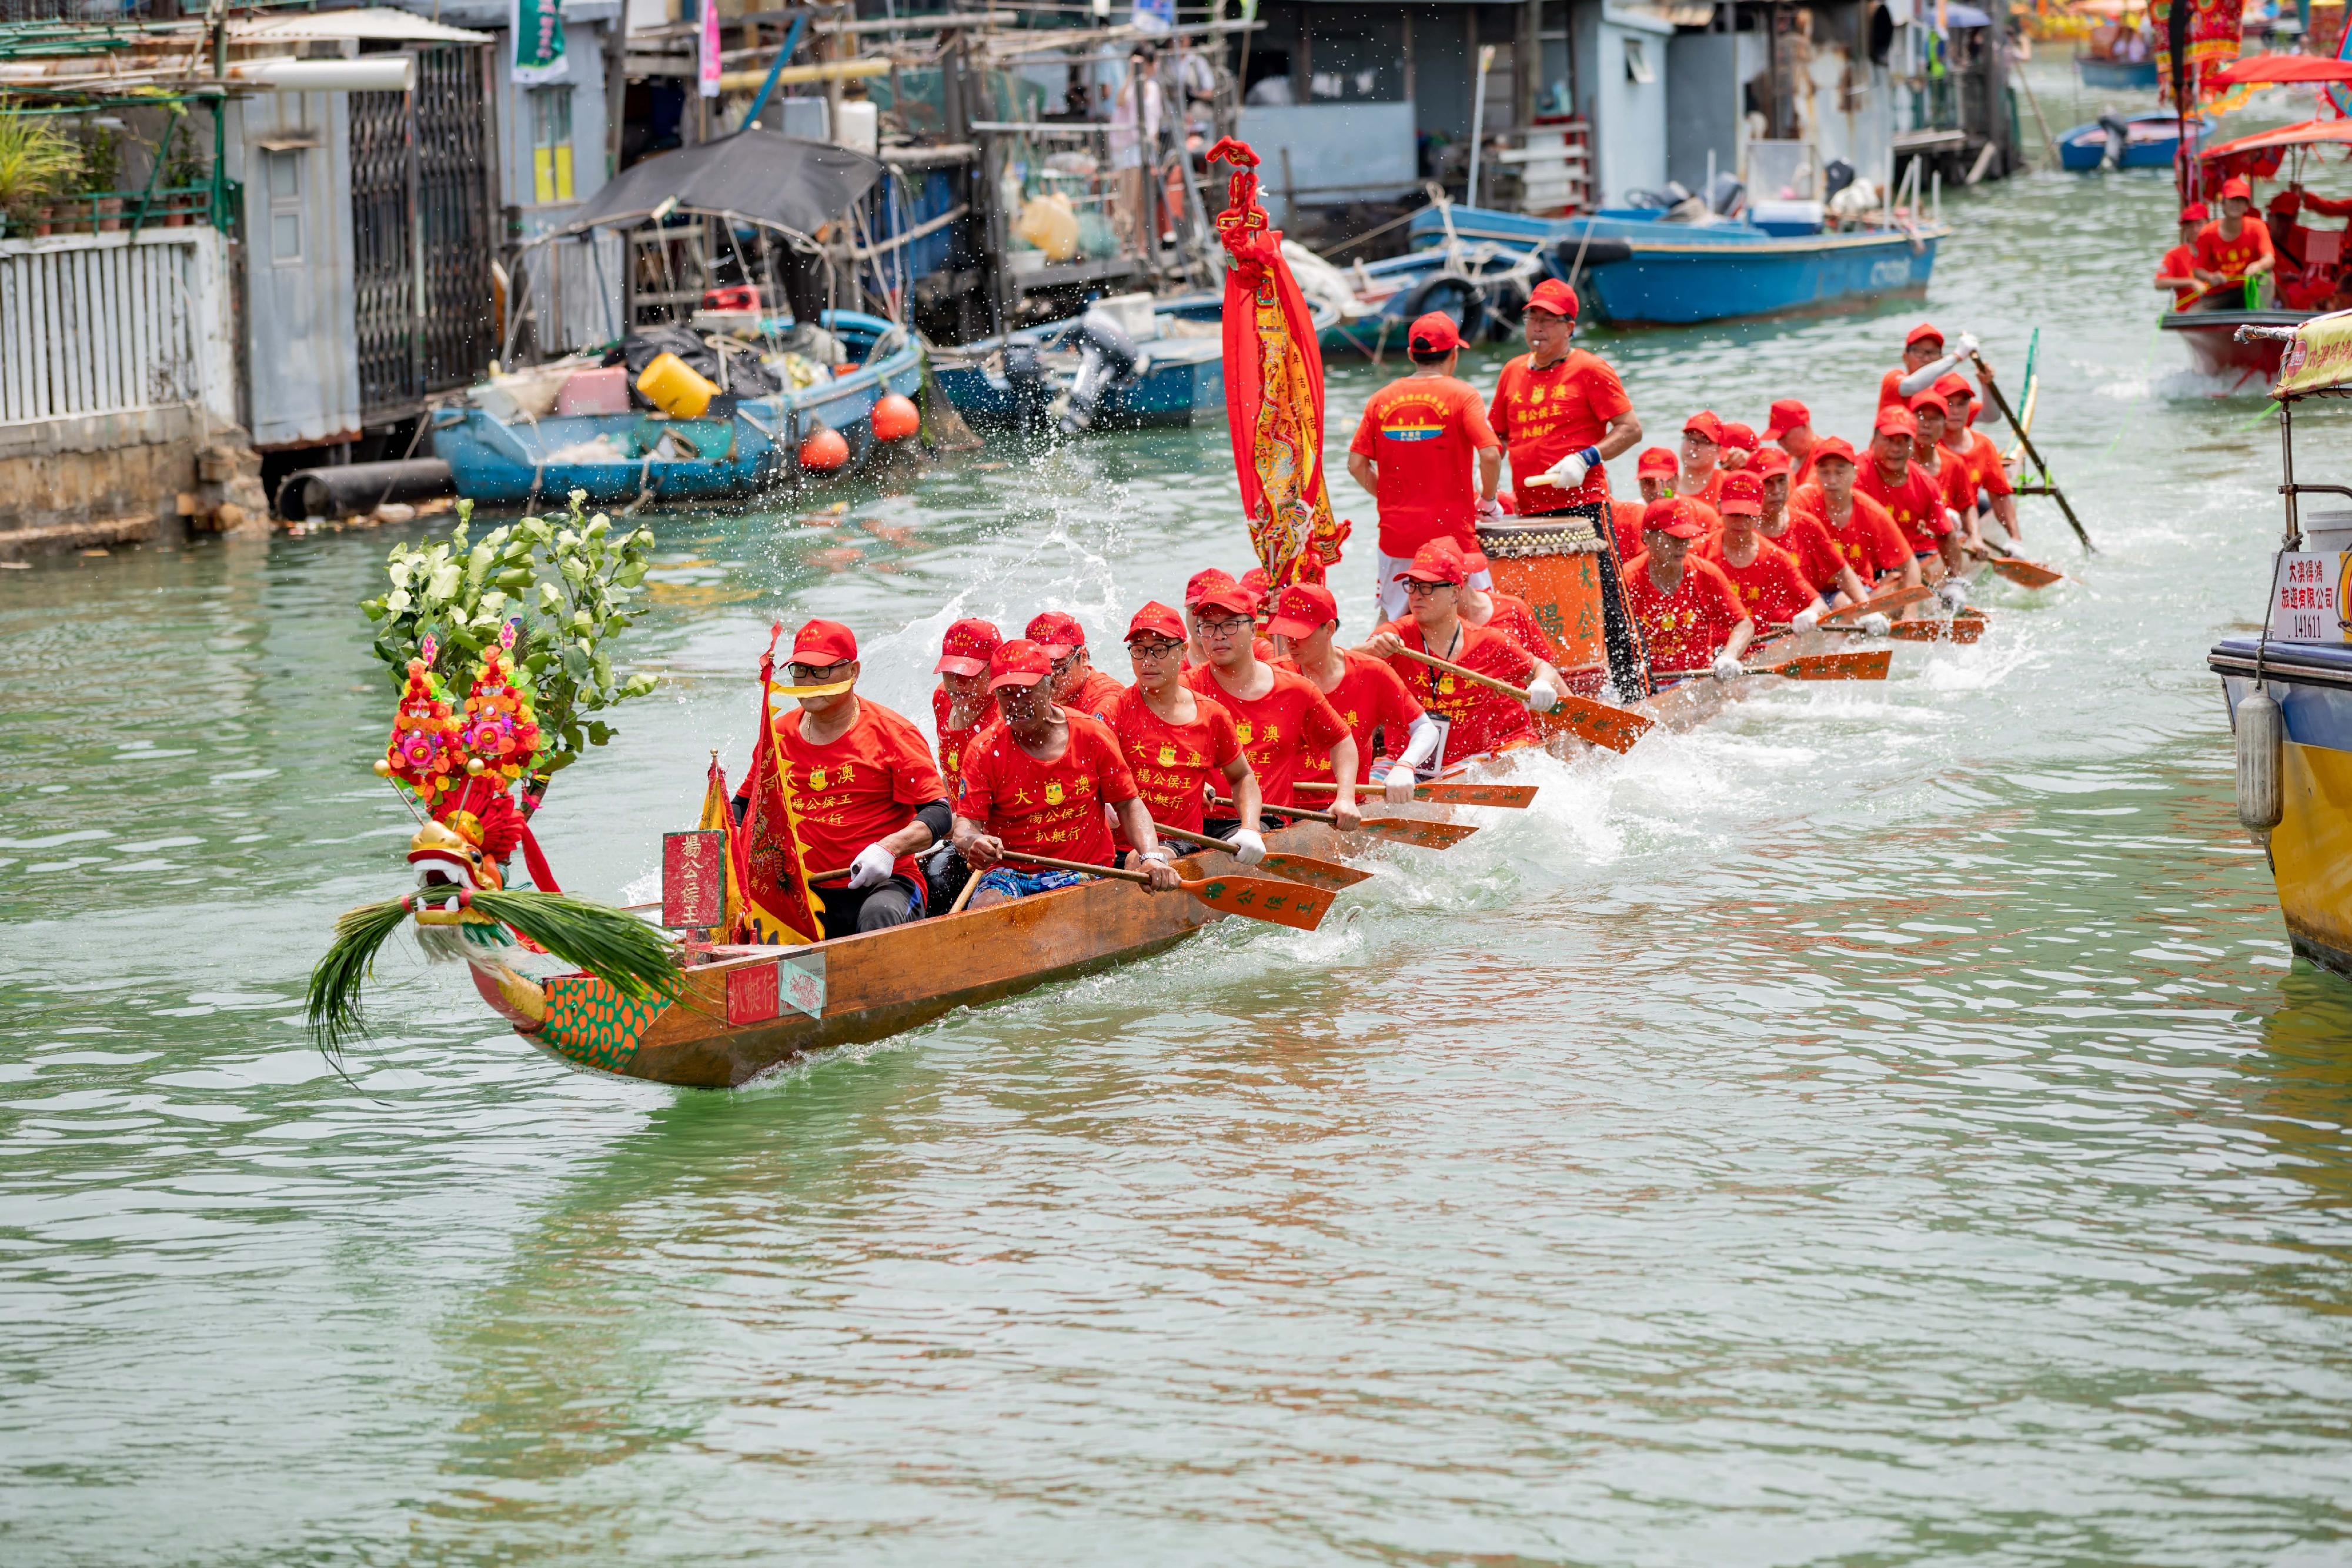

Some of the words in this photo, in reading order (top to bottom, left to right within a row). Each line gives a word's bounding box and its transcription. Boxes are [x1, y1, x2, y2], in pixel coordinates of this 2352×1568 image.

[2289, 560, 2323, 584] 大澳得鴻
[2281, 587, 2333, 610] 旅遊有限公司
[2294, 614, 2321, 638] 141611
[1414, 671, 1429, 687] 大
[1262, 724, 1281, 743] 澳
[1129, 740, 1147, 758] 大
[1186, 750, 1202, 768] 澳
[1304, 755, 1331, 771] 扒艇
[837, 763, 856, 784] 澳
[1137, 768, 1191, 789] 楊公侯王
[1014, 788, 1034, 805] 大
[1074, 775, 1091, 795] 澳
[1139, 790, 1184, 809] 扒艇行
[791, 794, 853, 812] 楊公侯王
[1035, 826, 1081, 842] 扒艇行
[680, 835, 704, 924] 楊公侯王
[730, 970, 777, 1019] 扒艇行
